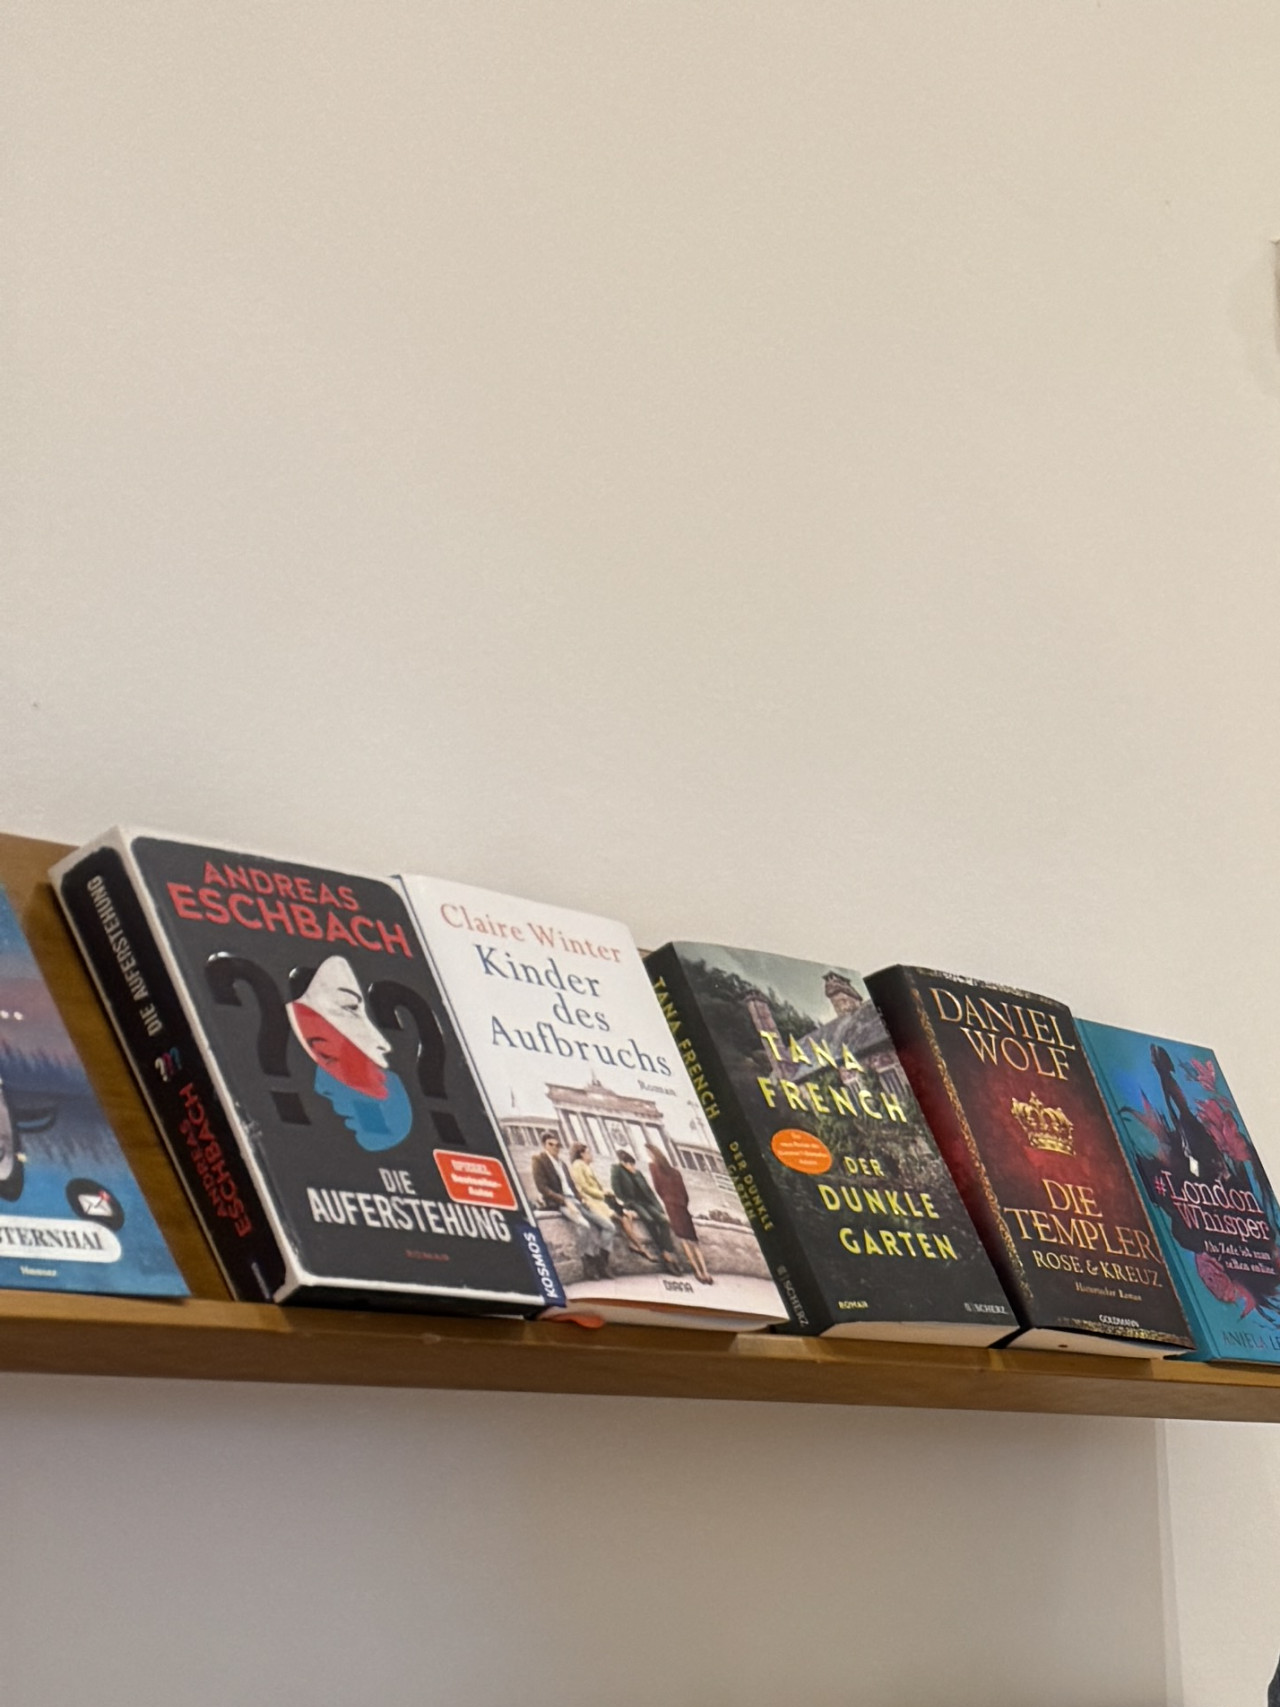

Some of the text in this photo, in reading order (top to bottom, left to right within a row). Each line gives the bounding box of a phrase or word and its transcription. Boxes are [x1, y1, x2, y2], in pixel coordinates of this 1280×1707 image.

[204, 861, 360, 911] ANDREAS
[167, 881, 414, 959] ESCHBACH
[440, 903, 621, 963] Claire Winter
[87, 876, 163, 1037] DIE AUFERSTEHUNG
[473, 944, 600, 997] Kinder
[552, 992, 610, 1031] des
[930, 988, 1075, 1050] DANIEL
[491, 1015, 672, 1077] Aufbruchs
[652, 977, 721, 1120] TANA FRENCH
[759, 1030, 865, 1073] TANA
[960, 1027, 1070, 1080] WOLF
[757, 1076, 907, 1123] FRENCH
[179, 1082, 252, 1237] ESCHBACH
[379, 1168, 416, 1195] DIE
[843, 1156, 885, 1177] DER
[307, 1187, 512, 1242] AUFERSTEHUNG
[743, 1173, 775, 1232] DUNKLE
[818, 1184, 940, 1219] DUNKLE
[1042, 1179, 1103, 1217] DIE
[1155, 1170, 1264, 1214] #London
[839, 1227, 958, 1260] GARTEN
[1004, 1207, 1165, 1265] TEMPLER
[1173, 1202, 1271, 1242] Whisper
[524, 1232, 558, 1298] KOSMOS
[1033, 1251, 1164, 1288] ROSE & KREUZ
[838, 1300, 868, 1310] ROMAN
